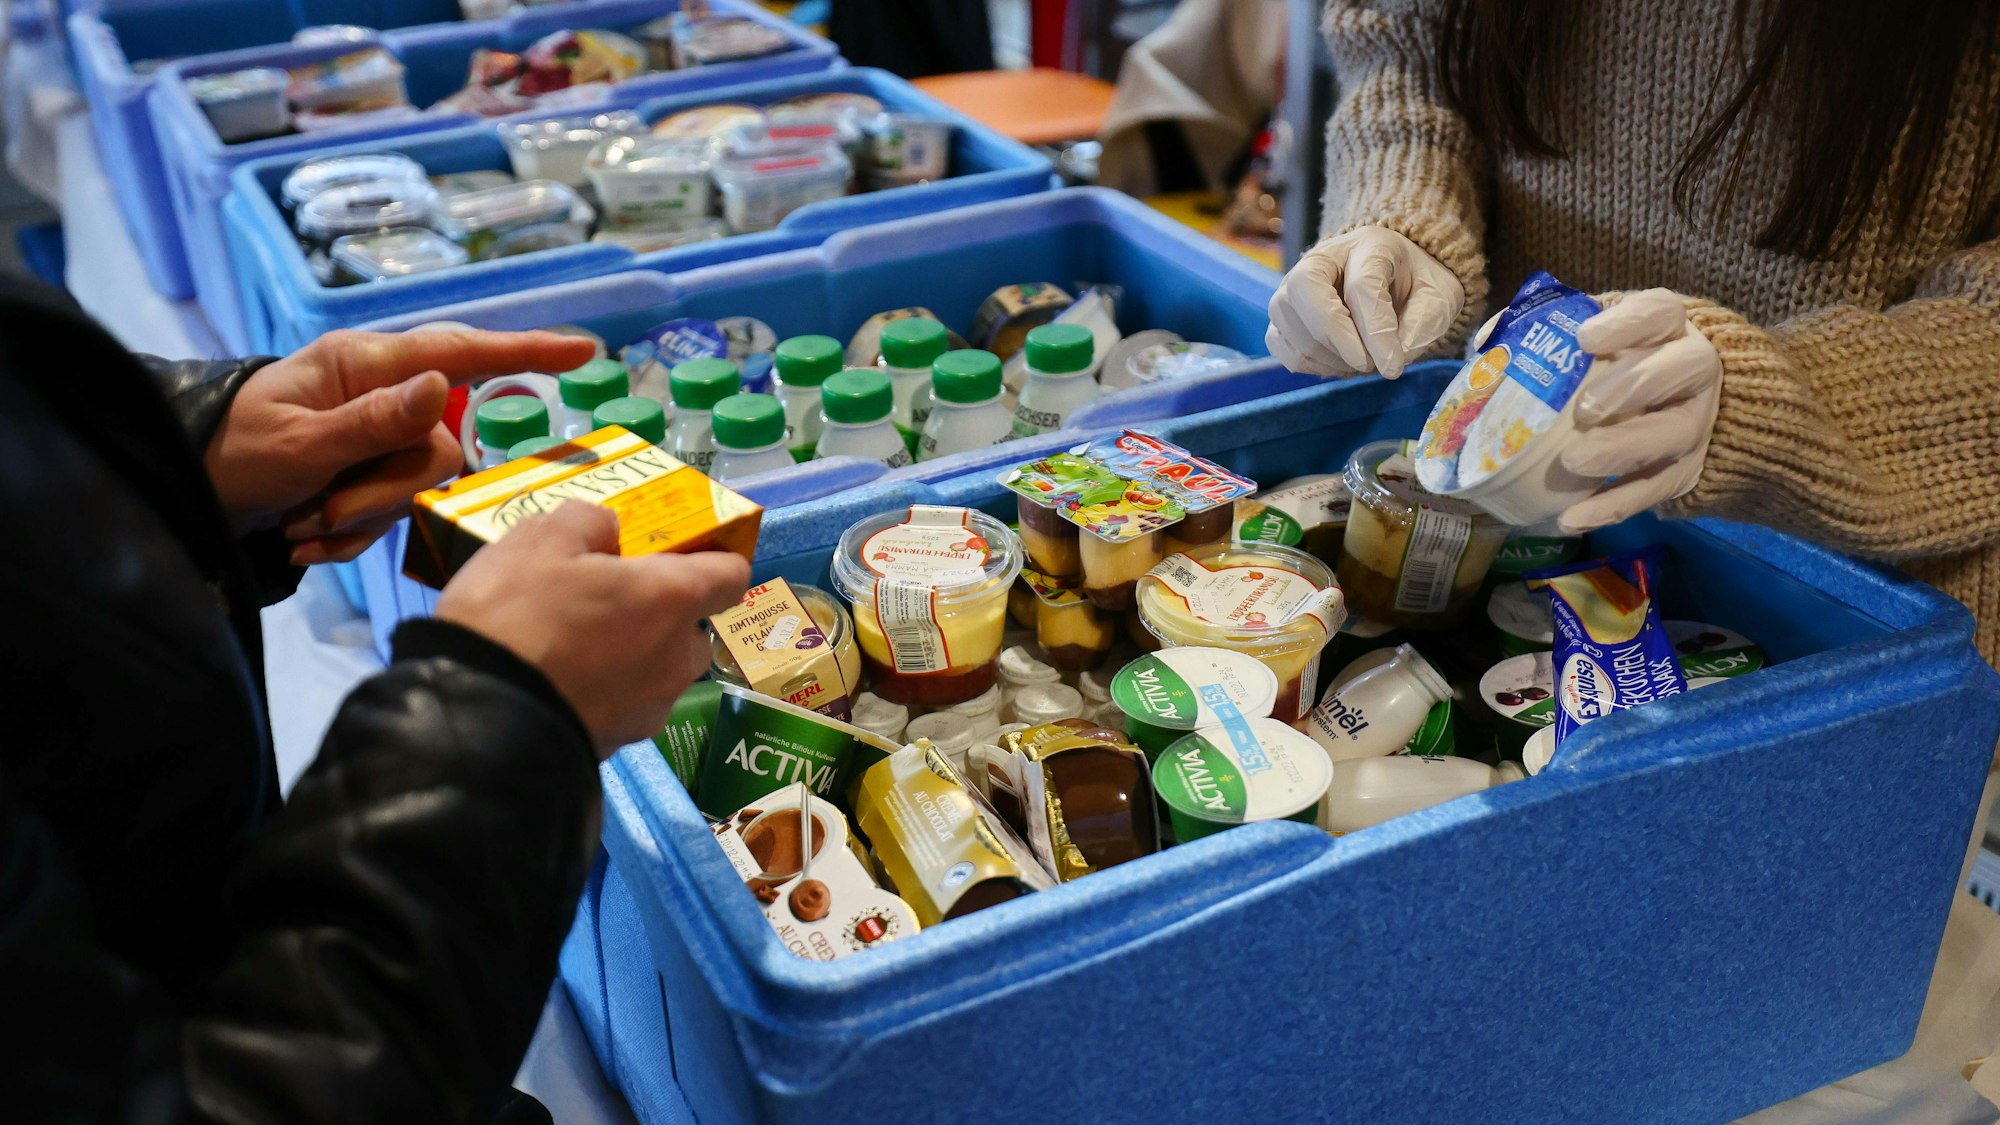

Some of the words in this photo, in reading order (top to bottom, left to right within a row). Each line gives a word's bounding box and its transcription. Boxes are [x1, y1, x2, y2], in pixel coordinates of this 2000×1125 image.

[1520, 321, 1582, 374] ELINAS
[1014, 405, 1062, 428] ECHSER
[1136, 454, 1238, 503] PAUL
[740, 584, 774, 603] ERL
[727, 600, 791, 634] ZIMTMOUSSE
[741, 624, 776, 647] PFLAU
[1133, 667, 1184, 720] ACTIVIA
[754, 730, 791, 748] natürliche
[791, 741, 815, 756] Bifidus
[724, 736, 840, 797] ACTIVIA
[1176, 748, 1233, 811] ACTIVIA
